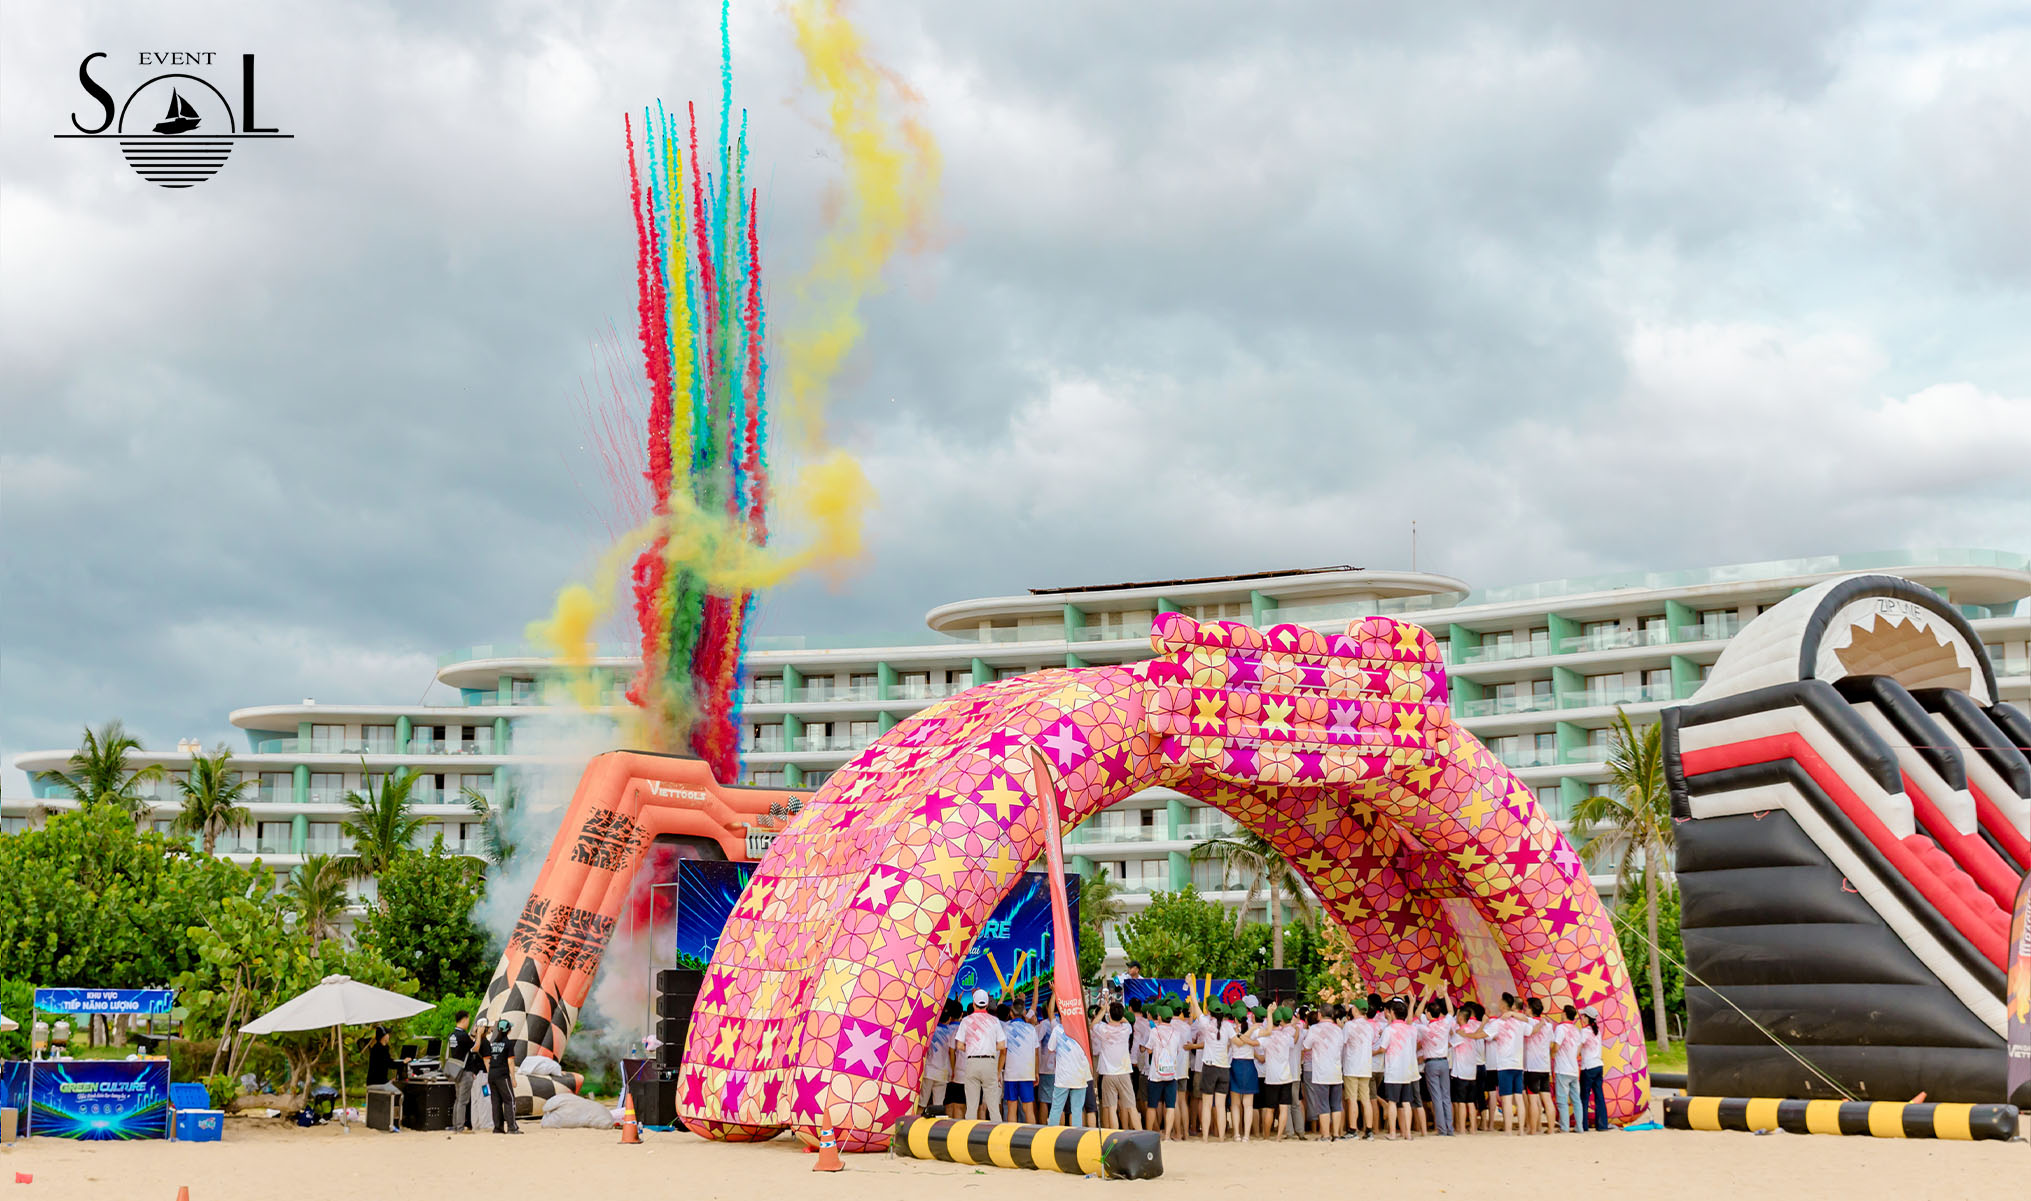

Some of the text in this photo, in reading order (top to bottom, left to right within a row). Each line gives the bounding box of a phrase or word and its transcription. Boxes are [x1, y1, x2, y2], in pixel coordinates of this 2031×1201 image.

[86, 991, 102, 1000] KHU
[63, 998, 81, 1010] TIẾP
[82, 999, 109, 1010] NĂNG
[60, 1082, 147, 1093] GREEN CULTURE
